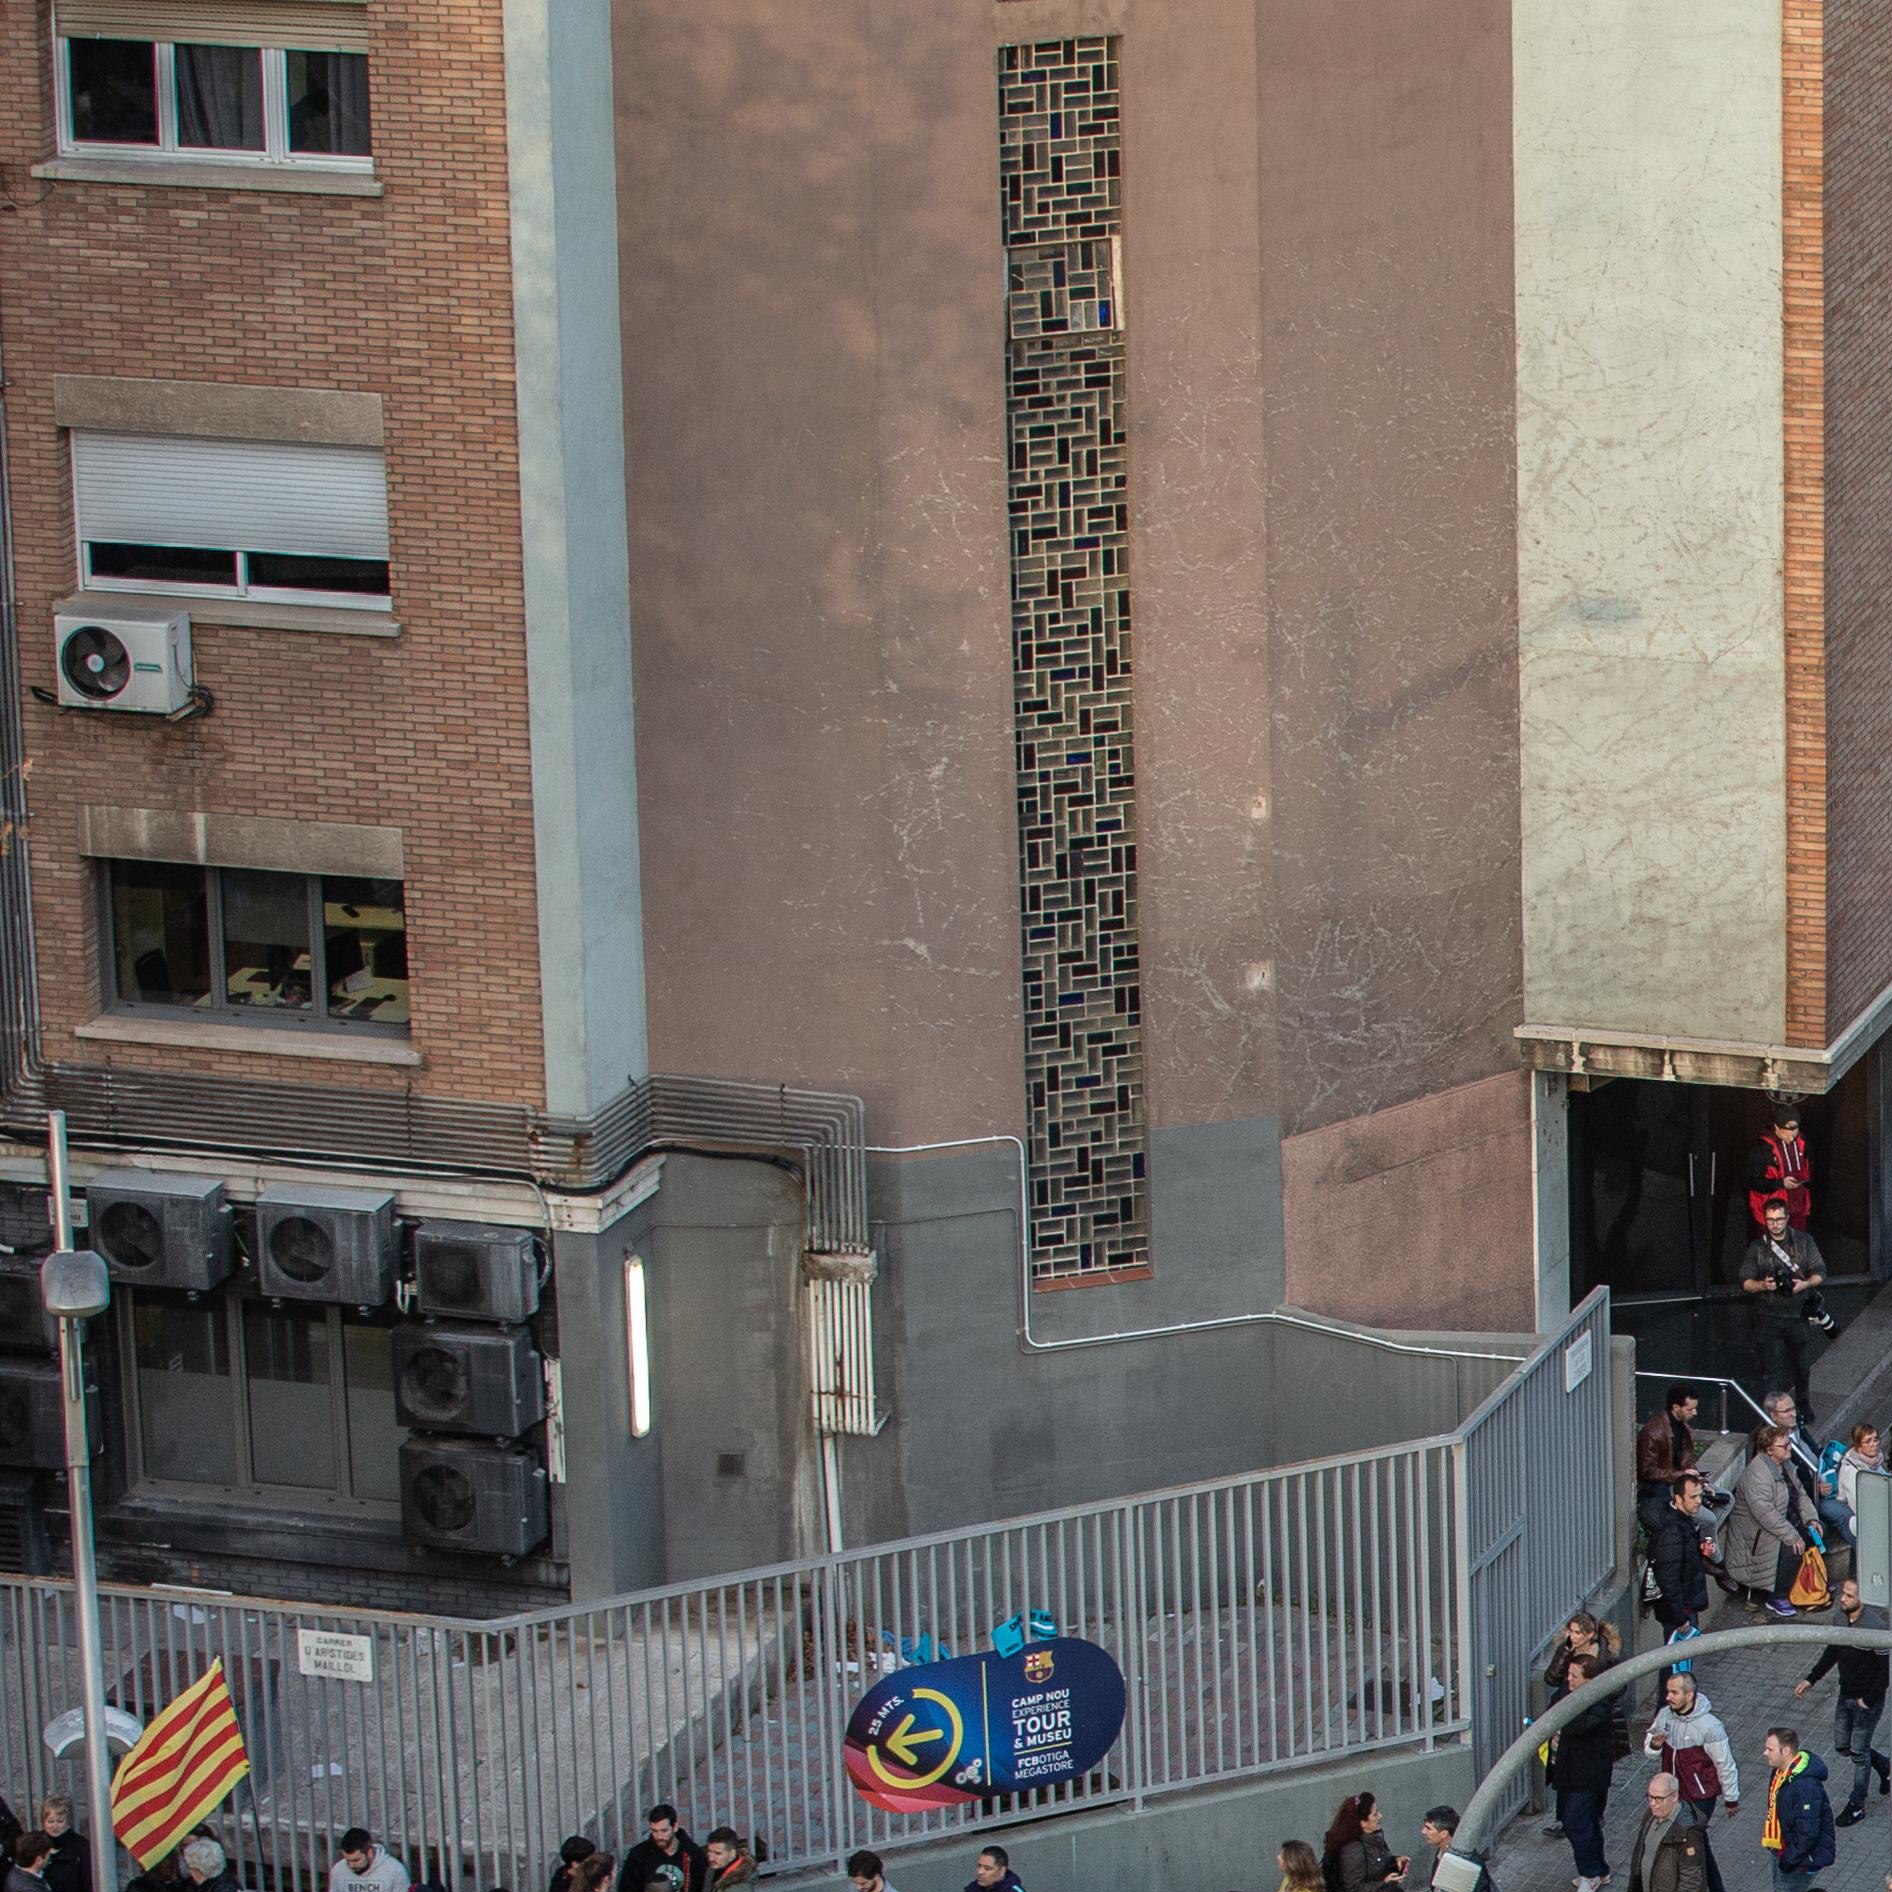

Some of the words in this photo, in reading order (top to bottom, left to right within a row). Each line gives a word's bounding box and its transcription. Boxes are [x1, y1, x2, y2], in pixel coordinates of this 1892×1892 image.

[1011, 1693, 1045, 1709] CAMP
[1046, 1688, 1071, 1702] NOU
[1012, 1698, 1071, 1720] EXPERIENCE
[868, 1718, 883, 1737] 25
[1012, 1709, 1072, 1737] TOUR
[1013, 1738, 1024, 1750] &
[1026, 1728, 1072, 1748] MUSEU
[1014, 1758, 1074, 1780] MEGASTORE
[1017, 1749, 1070, 1770] FCBOTIGA
